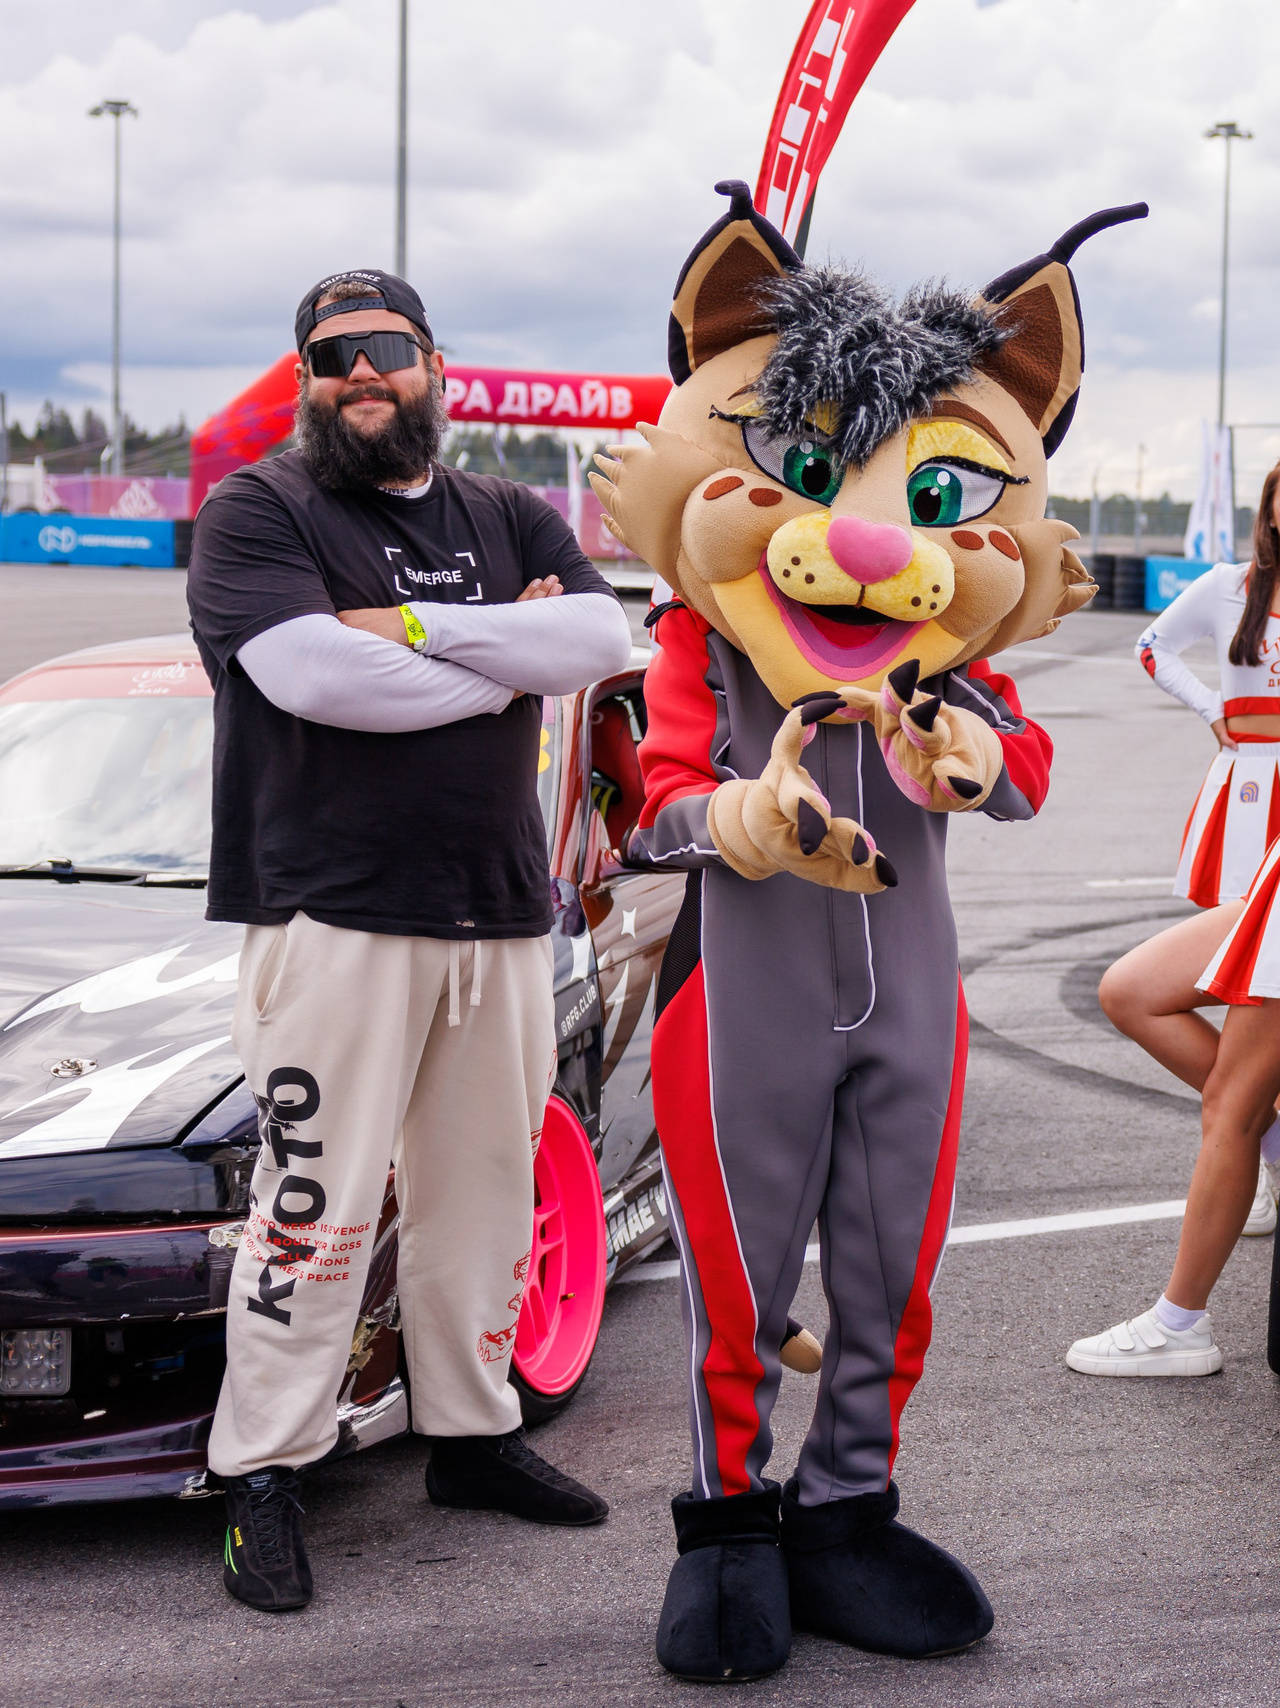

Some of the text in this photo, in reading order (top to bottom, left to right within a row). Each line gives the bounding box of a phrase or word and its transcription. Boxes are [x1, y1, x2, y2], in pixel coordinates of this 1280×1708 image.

[348, 272, 381, 283] FORCE
[444, 377, 633, 420] РА ДРАЙВ
[404, 566, 464, 586] EMERGE
[561, 984, 597, 1037] @RFG.CLUB
[247, 1066, 326, 1327] KYOTO
[256, 1214, 276, 1230] TWO
[281, 1223, 317, 1231] NEED
[328, 1222, 371, 1236] EVENGE
[265, 1237, 310, 1248] ABOUT
[331, 1240, 362, 1252] LOSS
[278, 1252, 302, 1261] ALL
[307, 1271, 349, 1282] PEACE
